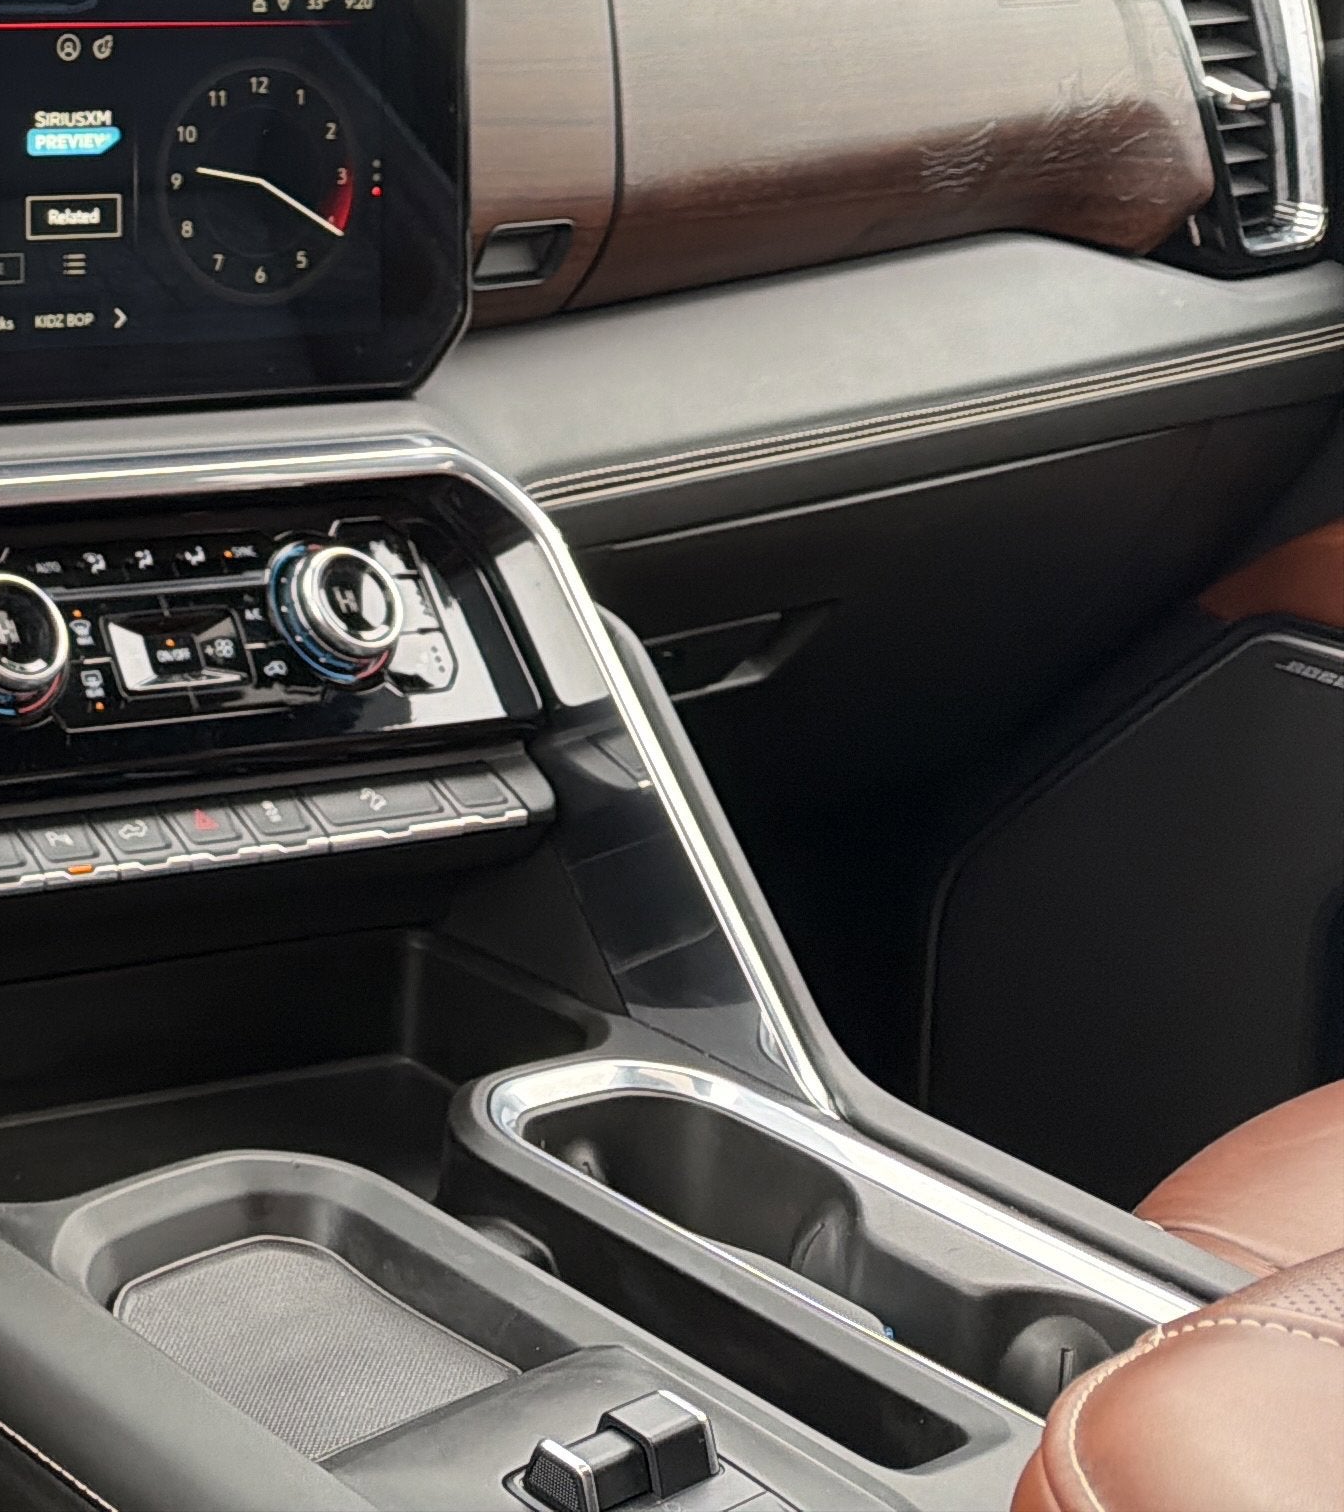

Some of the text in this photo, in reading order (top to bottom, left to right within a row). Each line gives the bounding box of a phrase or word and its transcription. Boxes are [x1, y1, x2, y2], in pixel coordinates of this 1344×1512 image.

[250, 76, 269, 94] 12
[208, 90, 228, 107] 11
[296, 89, 305, 106] 1
[34, 110, 112, 127] SIRIUSXM
[177, 125, 198, 143] 10
[325, 123, 337, 140] 2
[34, 133, 111, 150] PREVIEW
[170, 173, 183, 190] 9
[337, 168, 348, 185] 3
[48, 207, 101, 225] Related
[181, 220, 193, 238] 8
[213, 254, 225, 271] 7
[295, 250, 308, 269] 5
[254, 266, 266, 284] 6
[34, 313, 65, 329] KIDZ
[66, 312, 95, 328] BOP
